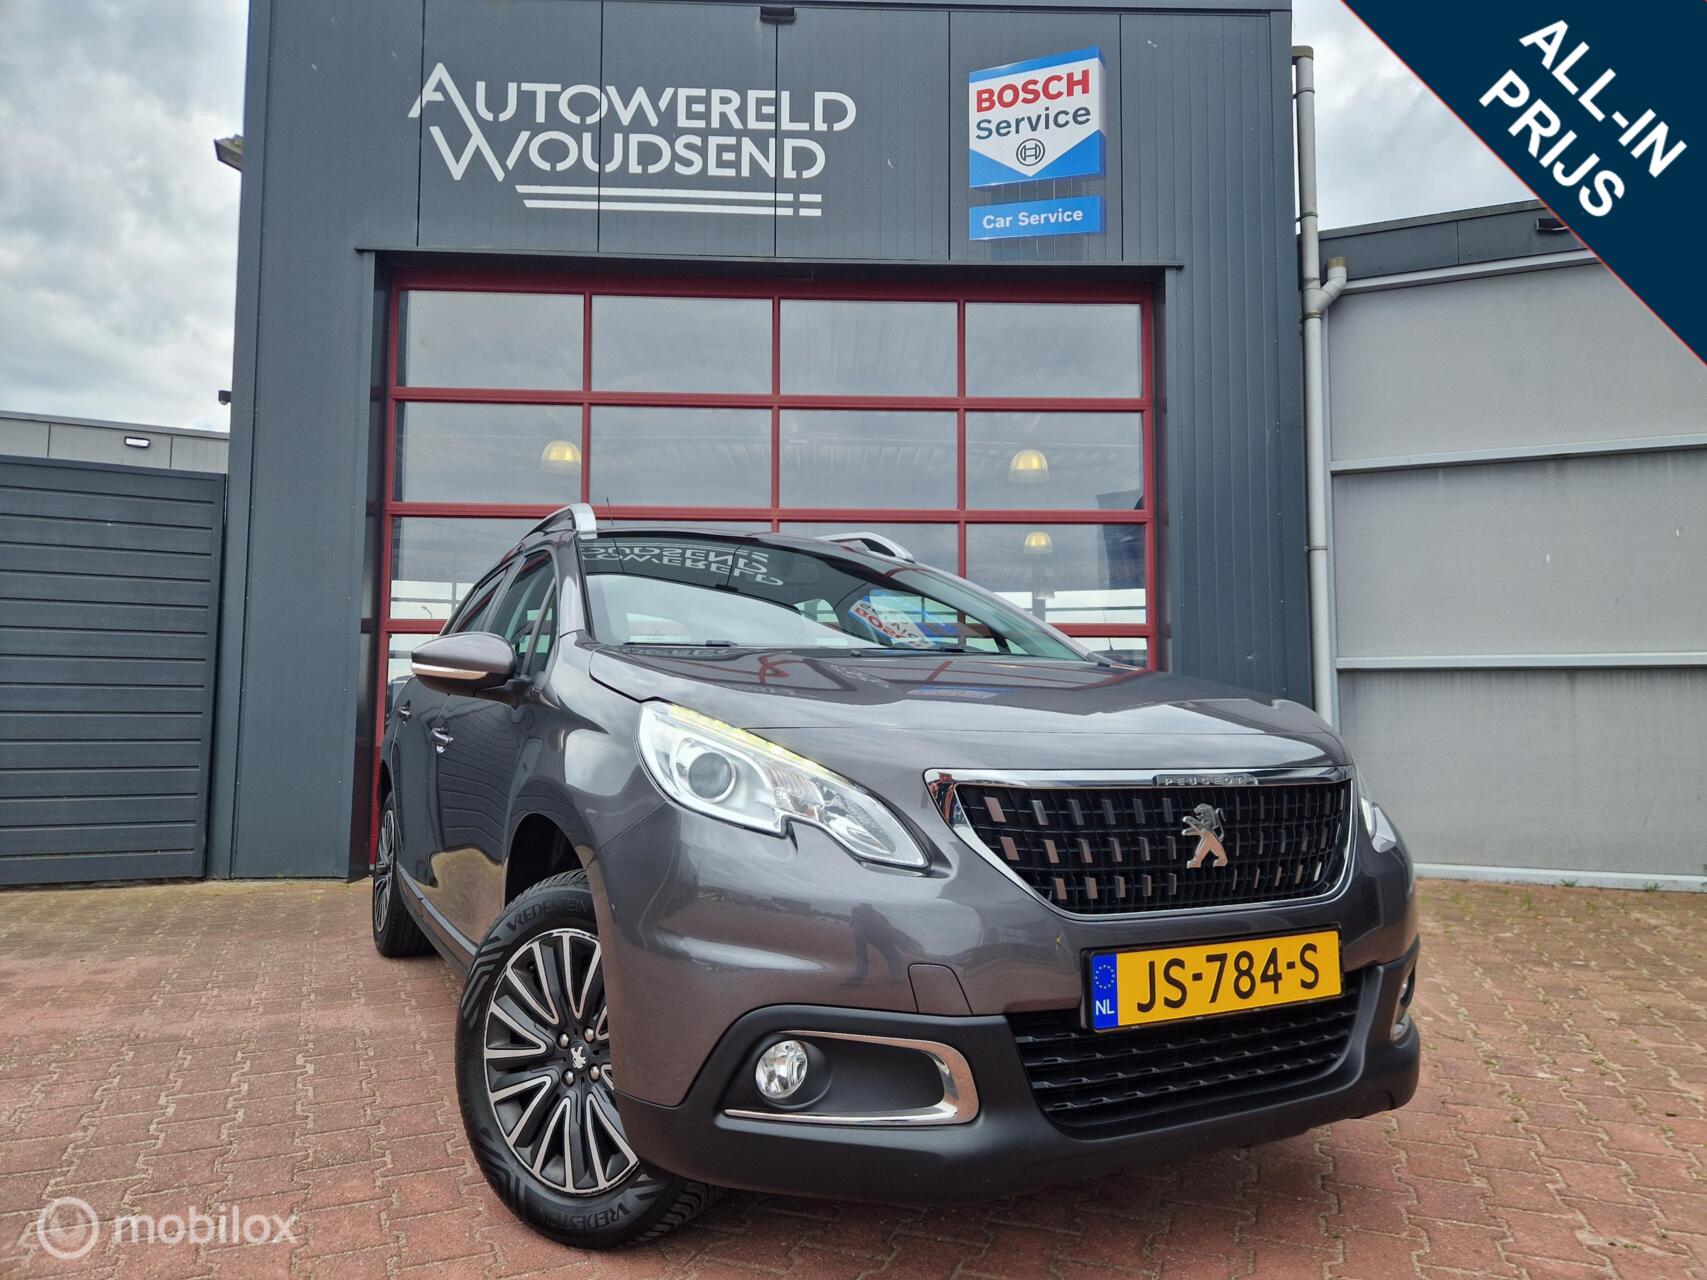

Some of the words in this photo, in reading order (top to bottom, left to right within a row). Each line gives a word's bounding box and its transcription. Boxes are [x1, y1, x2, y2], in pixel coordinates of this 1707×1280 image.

[407, 62, 857, 132] AUTOWERELD
[976, 69, 1090, 113] BOSCH
[976, 106, 1091, 140] Service
[429, 126, 826, 182] WOUDSEND
[982, 214, 1013, 230] Car
[1018, 208, 1083, 227] Service
[1165, 776, 1244, 786] PEUGEOT
[1136, 942, 1320, 1013] JS-784-S
[1095, 998, 1115, 1016] NL
